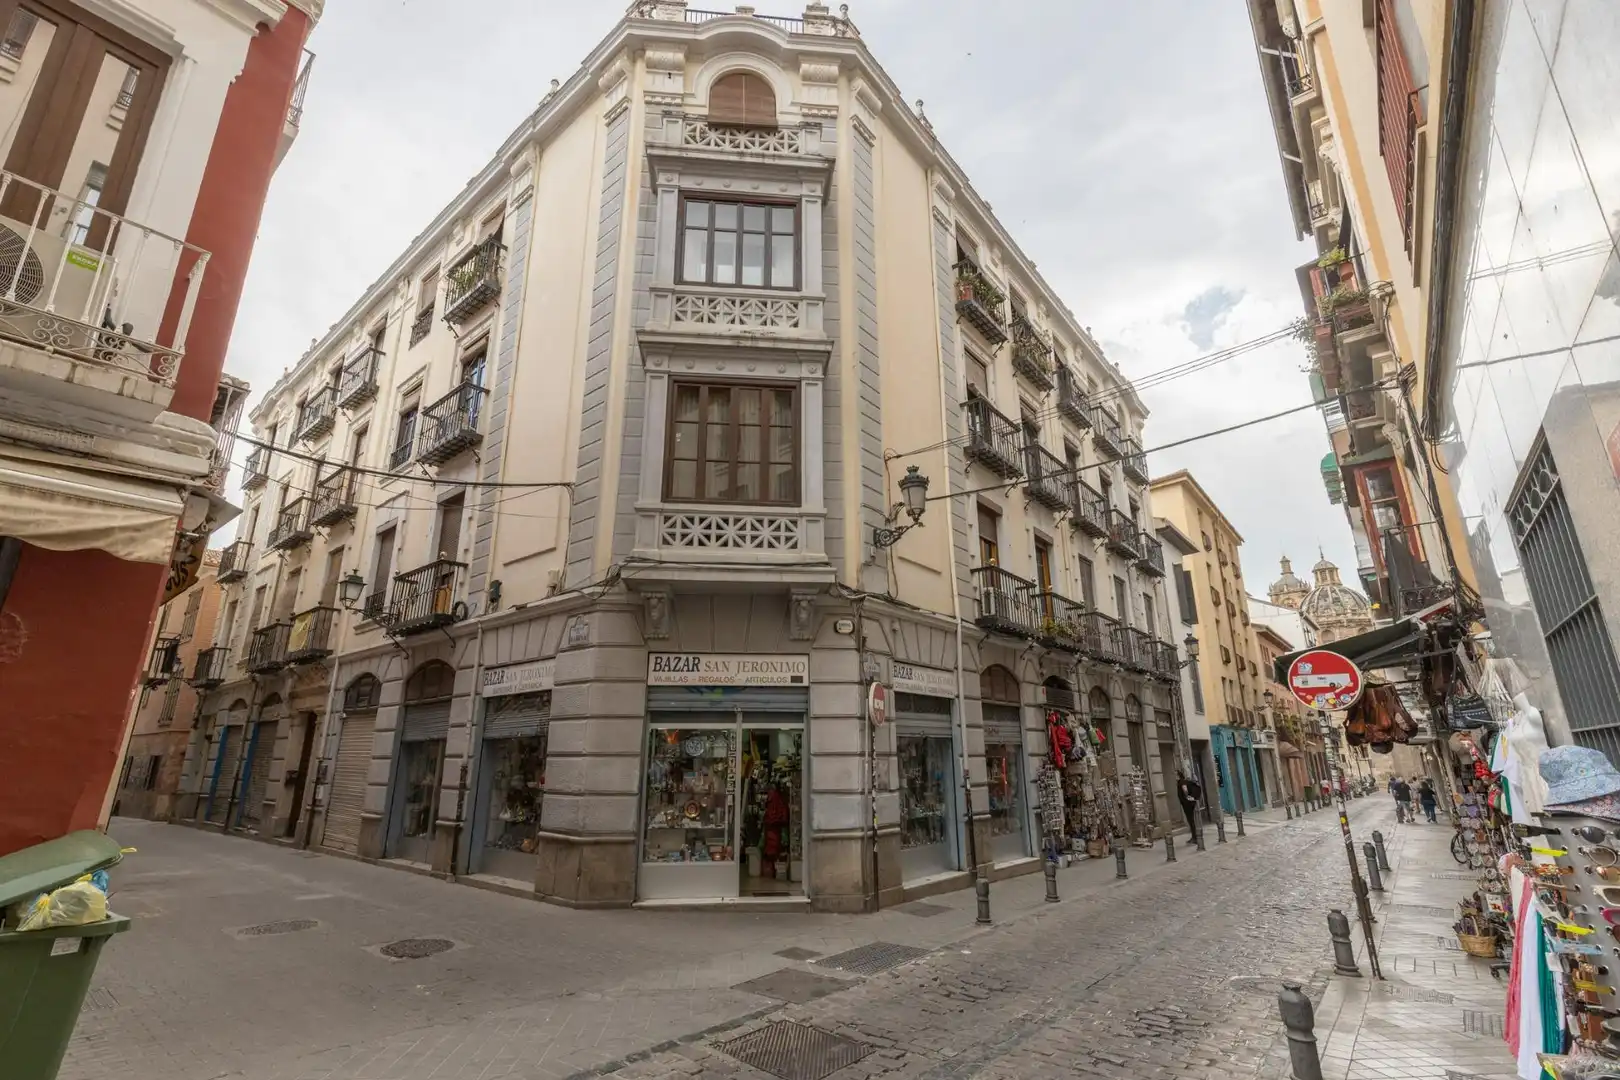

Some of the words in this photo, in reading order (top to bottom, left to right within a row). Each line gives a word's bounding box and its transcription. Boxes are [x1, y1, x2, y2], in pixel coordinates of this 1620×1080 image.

[652, 656, 701, 673] BAZAR
[703, 660, 731, 673] SAN
[735, 660, 806, 677] JERONIMO
[893, 665, 913, 680] BAZAR
[484, 669, 505, 687] BAZAR
[698, 675, 735, 683] REGALOS
